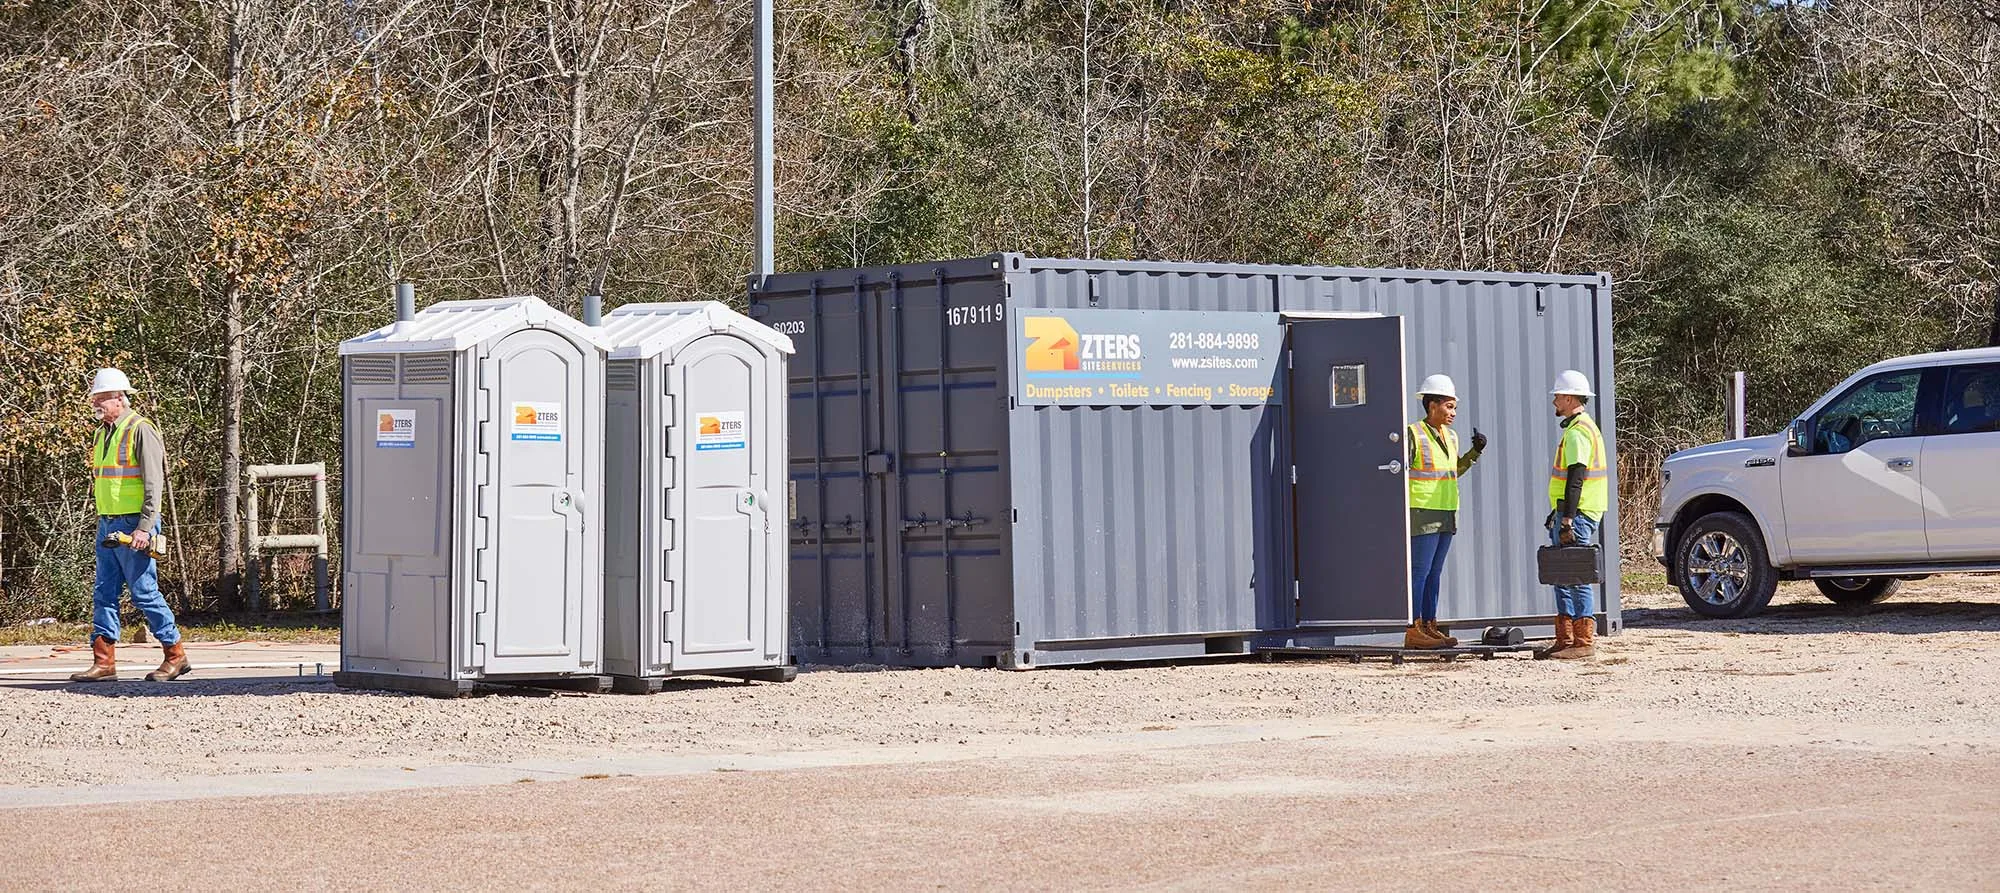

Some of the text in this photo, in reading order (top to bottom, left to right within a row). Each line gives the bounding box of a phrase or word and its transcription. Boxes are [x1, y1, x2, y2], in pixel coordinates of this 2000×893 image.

[1081, 334, 1141, 360] ZTERS
[1169, 332, 1259, 350] 281-884-9898
[1171, 356, 1258, 369] www.zsites.com
[1026, 383, 1274, 400] Dumpsters Toilets Fencing Storage
[537, 412, 558, 421] ZTERS
[394, 419, 412, 428] ZTERS
[721, 421, 742, 430] ZTERS
